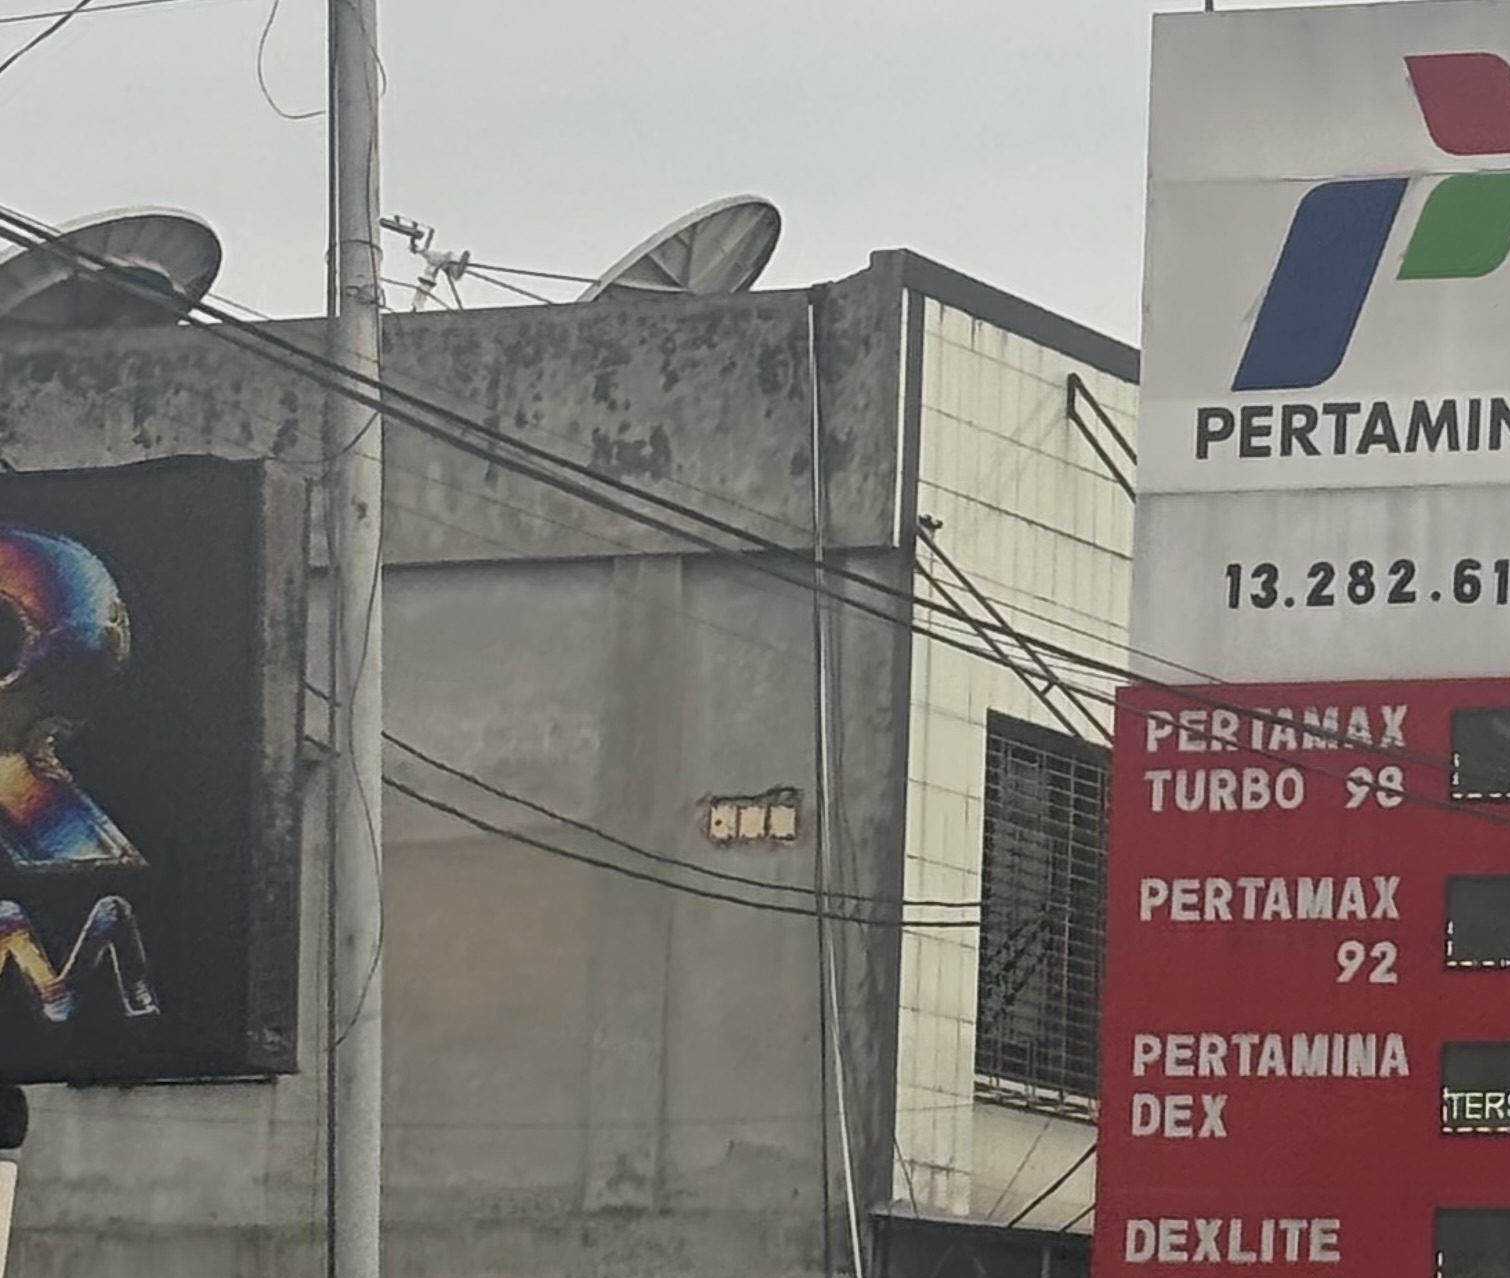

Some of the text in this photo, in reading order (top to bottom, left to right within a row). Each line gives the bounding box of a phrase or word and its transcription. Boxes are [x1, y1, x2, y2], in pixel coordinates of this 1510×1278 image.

[1146, 705, 1408, 752] PERTAMAX
[1144, 765, 1404, 812] TURBO 98
[1139, 876, 1400, 921] PERTAMAX
[1336, 940, 1398, 984] 92
[1133, 1033, 1409, 1077] PERTAMINA
[1131, 1093, 1227, 1138] DEX
[1125, 1218, 1341, 1263] DEXLITE
